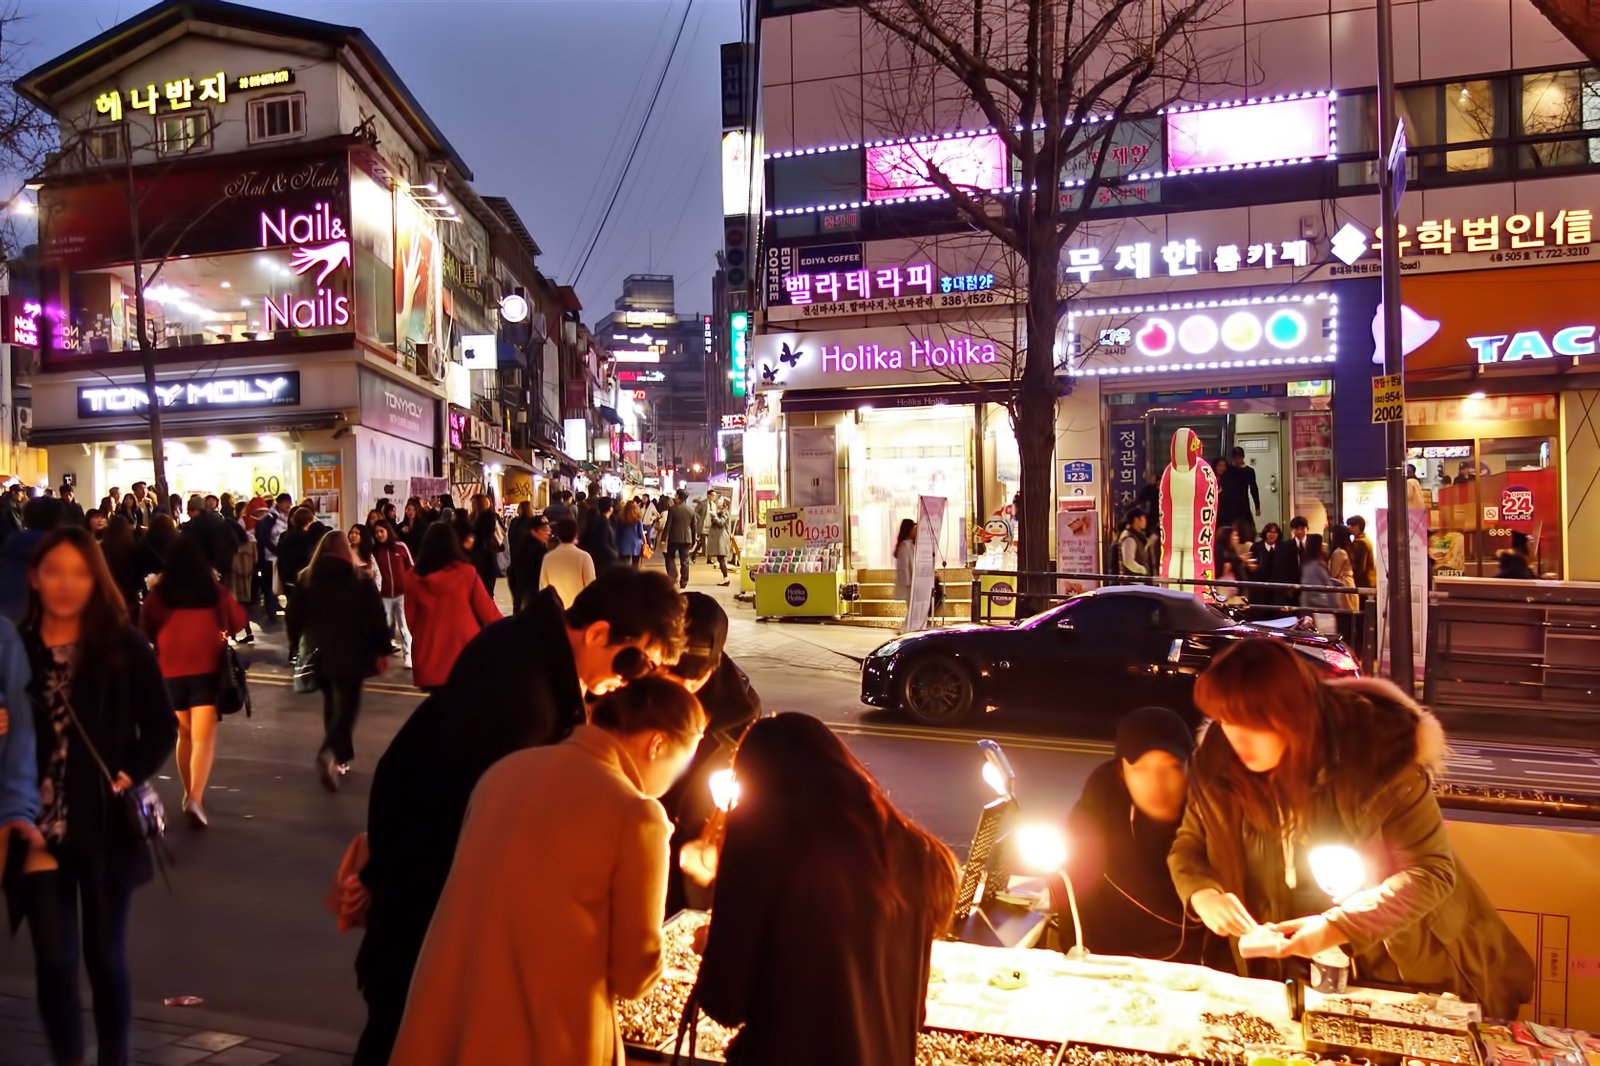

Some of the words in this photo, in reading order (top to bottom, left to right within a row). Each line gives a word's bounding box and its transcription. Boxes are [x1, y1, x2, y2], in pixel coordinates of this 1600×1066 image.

[95, 71, 226, 122] 헤나반지
[768, 249, 780, 301] COFFEE
[801, 257, 827, 266] EDIYA
[827, 253, 861, 264] COFFEE
[1066, 239, 1202, 283] 무제한
[784, 264, 932, 305] 벨라테라피
[264, 288, 350, 332] Nails
[821, 345, 902, 373] Holika
[909, 338, 997, 368] Holika
[1466, 325, 1600, 364] TAC
[188, 376, 286, 405] MOLY
[385, 391, 423, 418] TONYMOLY
[1374, 405, 1403, 422] 2002
[1119, 430, 1136, 486] 정관희
[255, 475, 280, 497] 30
[1503, 497, 1533, 514] 24
